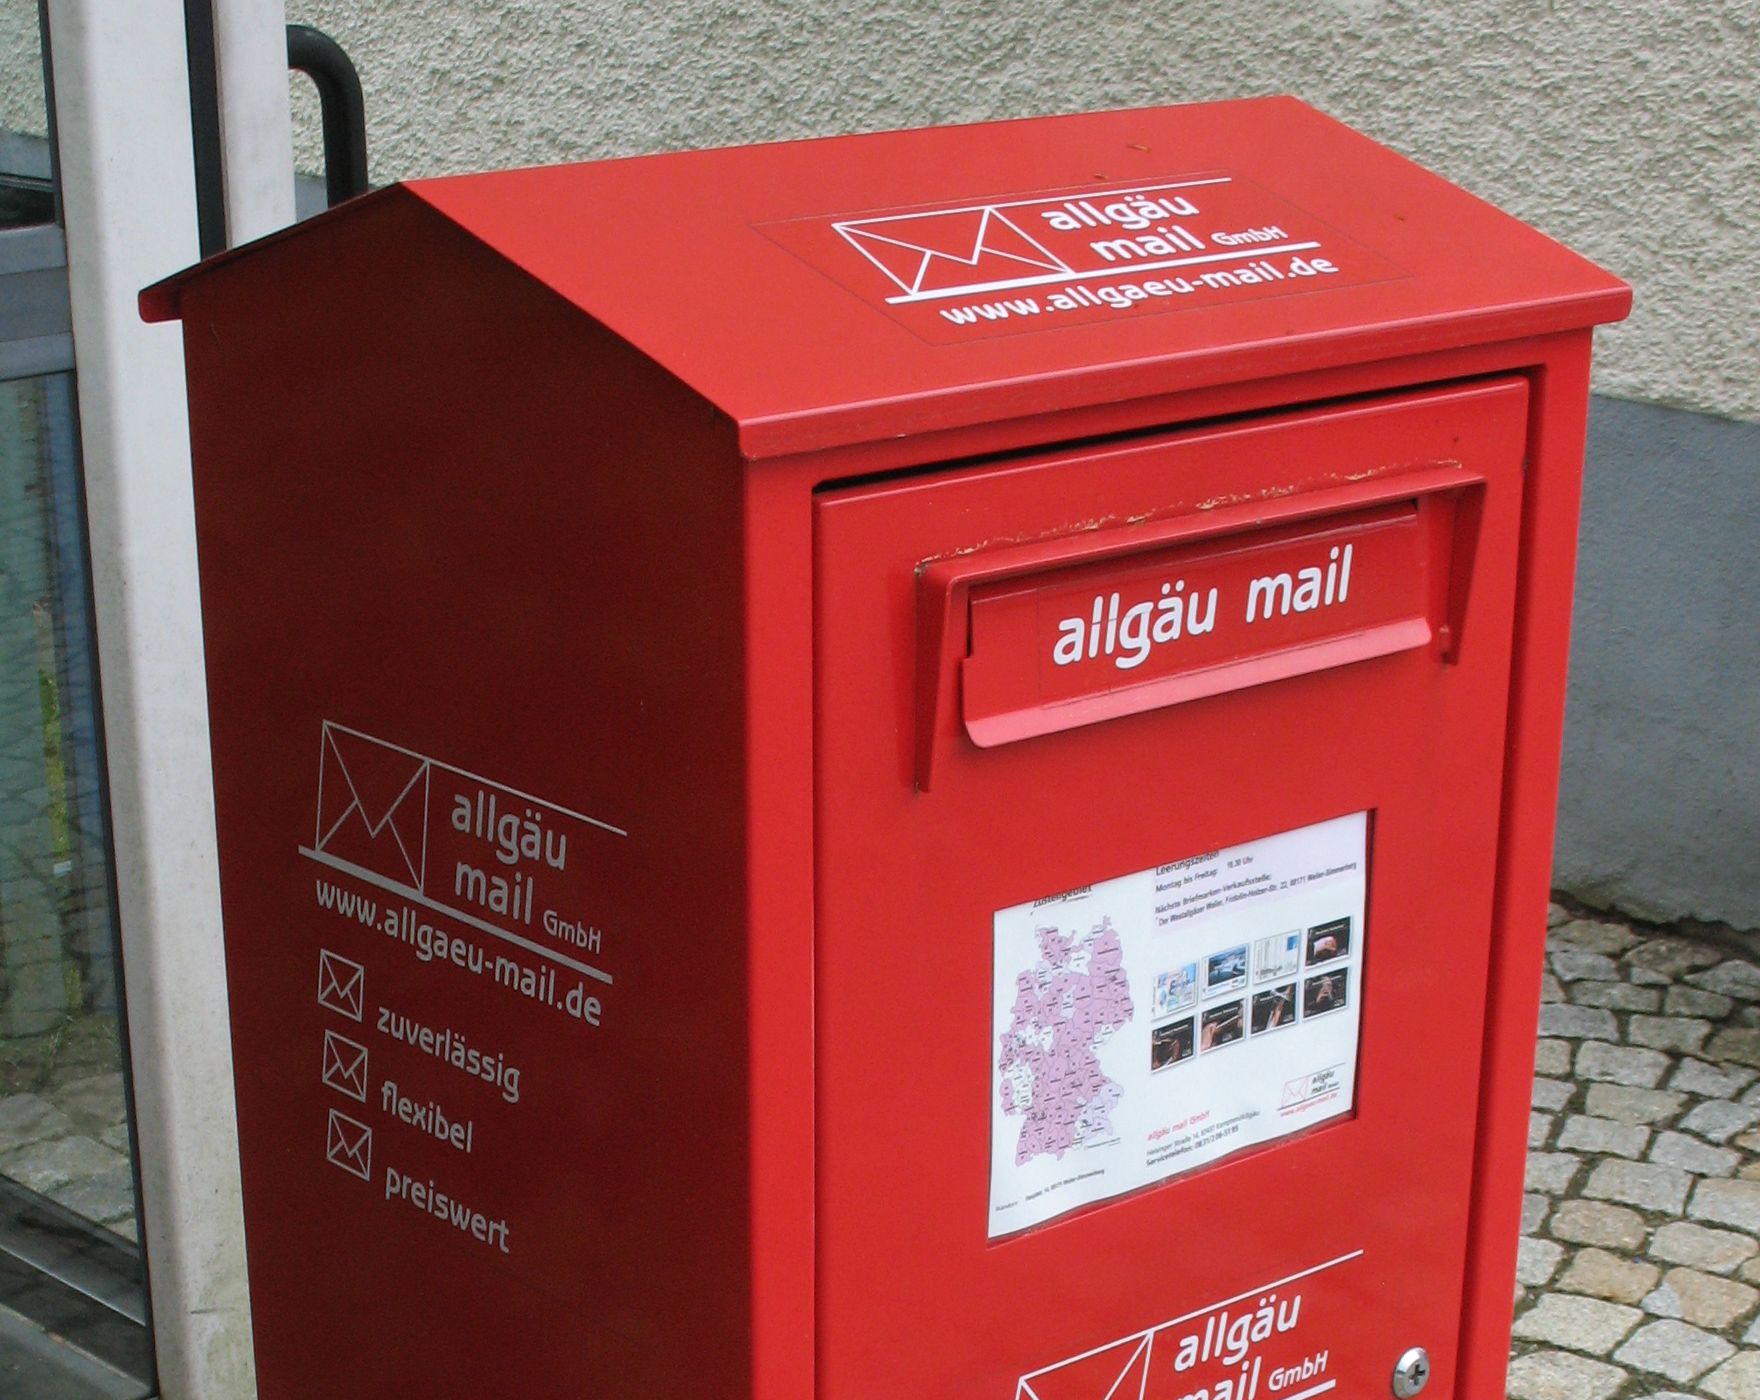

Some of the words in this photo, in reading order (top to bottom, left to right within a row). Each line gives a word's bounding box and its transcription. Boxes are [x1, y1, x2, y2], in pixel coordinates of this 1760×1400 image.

[1041, 194, 1199, 230] allgäu
[1089, 225, 1206, 262] mail
[1211, 225, 1288, 246] GmbH
[939, 254, 1339, 325] www.allgaeu-mail.de
[1053, 579, 1218, 670] allgäu
[1246, 543, 1353, 624] mail
[451, 790, 567, 871] allgäu
[454, 860, 534, 925] mail
[542, 909, 601, 955] GmbH
[315, 878, 602, 1027] www.allgaeu-mail.de
[376, 1005, 521, 1104] zuverlässig
[380, 1080, 474, 1153] flexibel
[385, 1166, 510, 1255] preiswert
[1174, 1295, 1302, 1372] allgäu
[1268, 1349, 1329, 1392] GmbH
